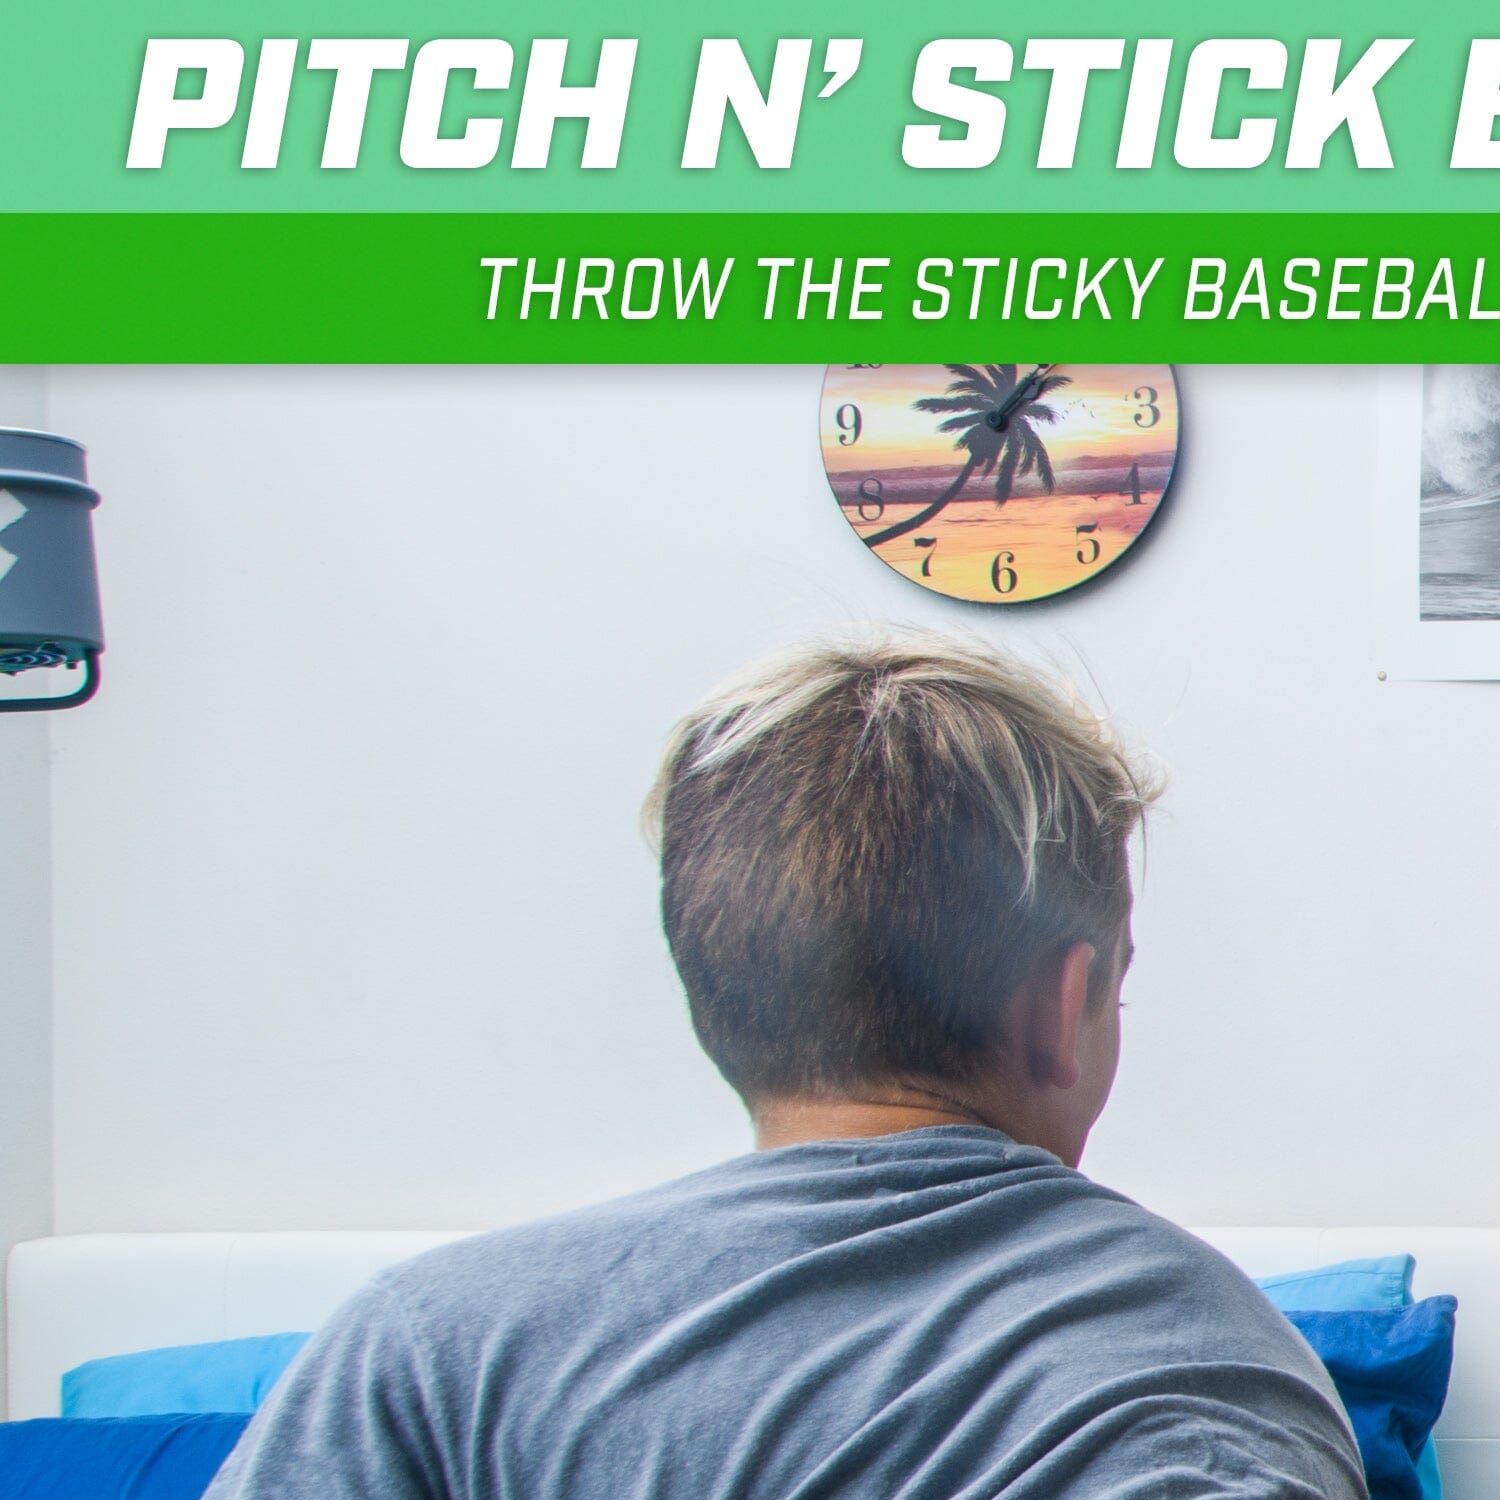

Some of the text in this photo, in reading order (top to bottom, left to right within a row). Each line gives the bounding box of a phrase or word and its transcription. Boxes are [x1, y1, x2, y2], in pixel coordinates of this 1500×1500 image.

[835, 403, 862, 446] 9
[1133, 385, 1161, 429] 3
[857, 477, 885, 521] 8
[1119, 463, 1147, 505] 4
[913, 537, 938, 577] 7
[1075, 523, 1101, 565] 5
[990, 551, 1018, 594] 6
